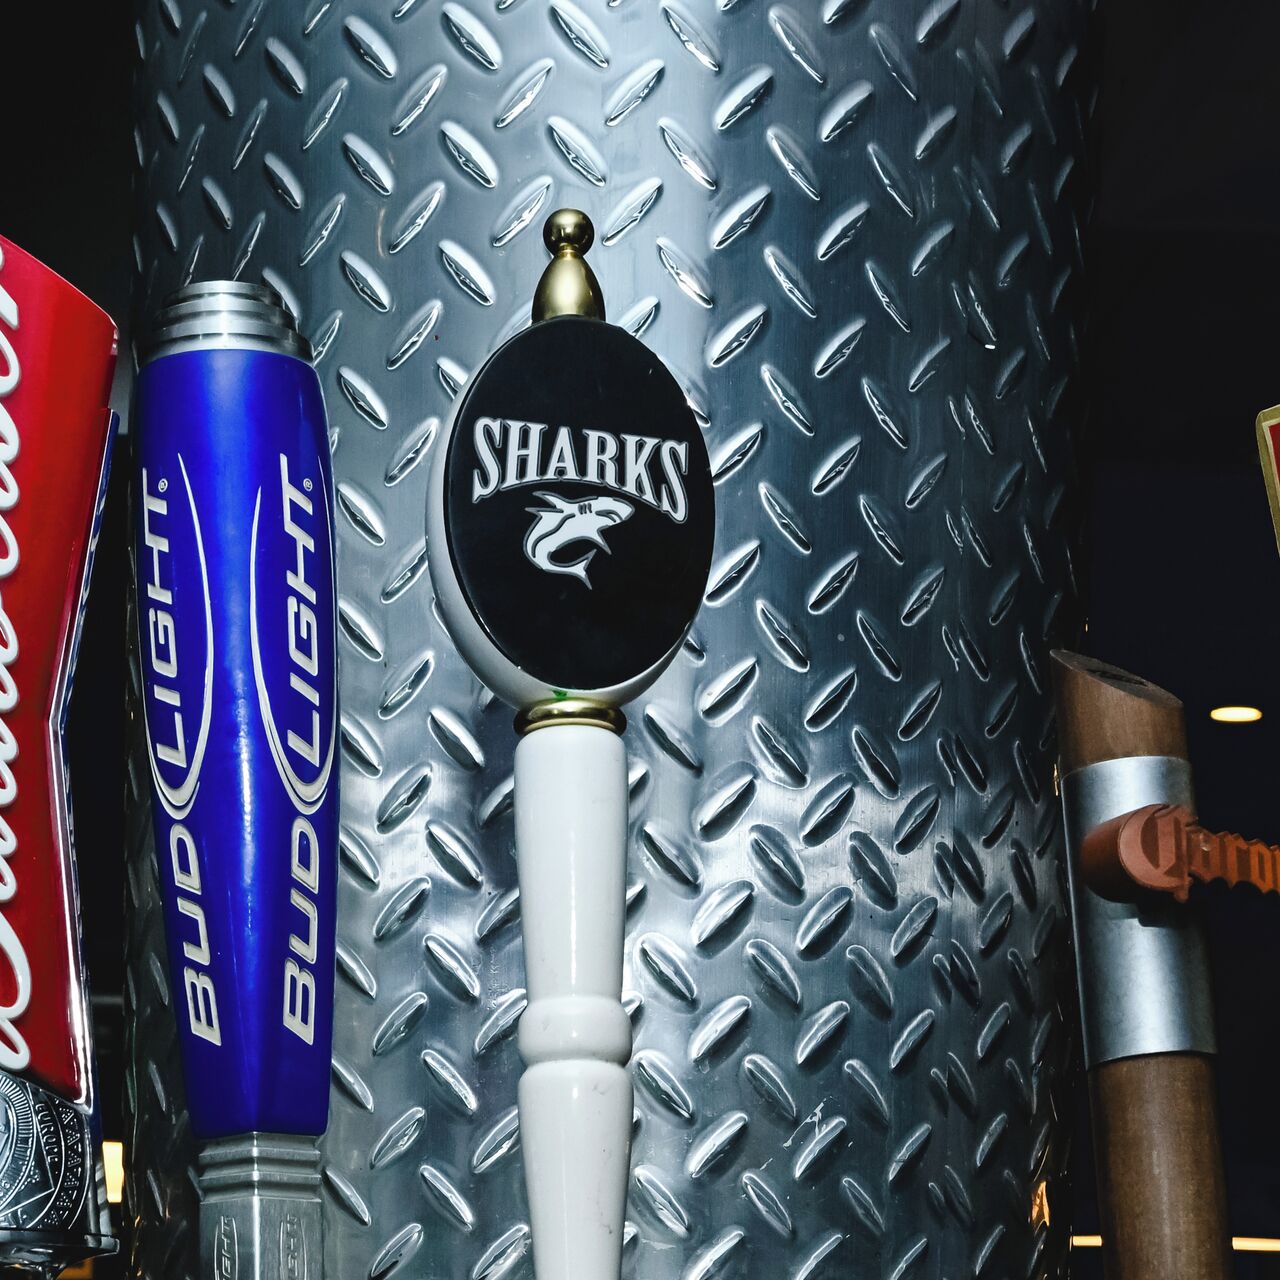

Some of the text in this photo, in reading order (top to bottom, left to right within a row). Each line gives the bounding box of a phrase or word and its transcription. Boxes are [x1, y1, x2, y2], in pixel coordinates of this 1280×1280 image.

[472, 415, 689, 524] SHARKS
[142, 466, 222, 1046] BUD LIGHT
[280, 453, 320, 1045] BUD LIGHT
[34, 1103, 59, 1164] EUROPE
